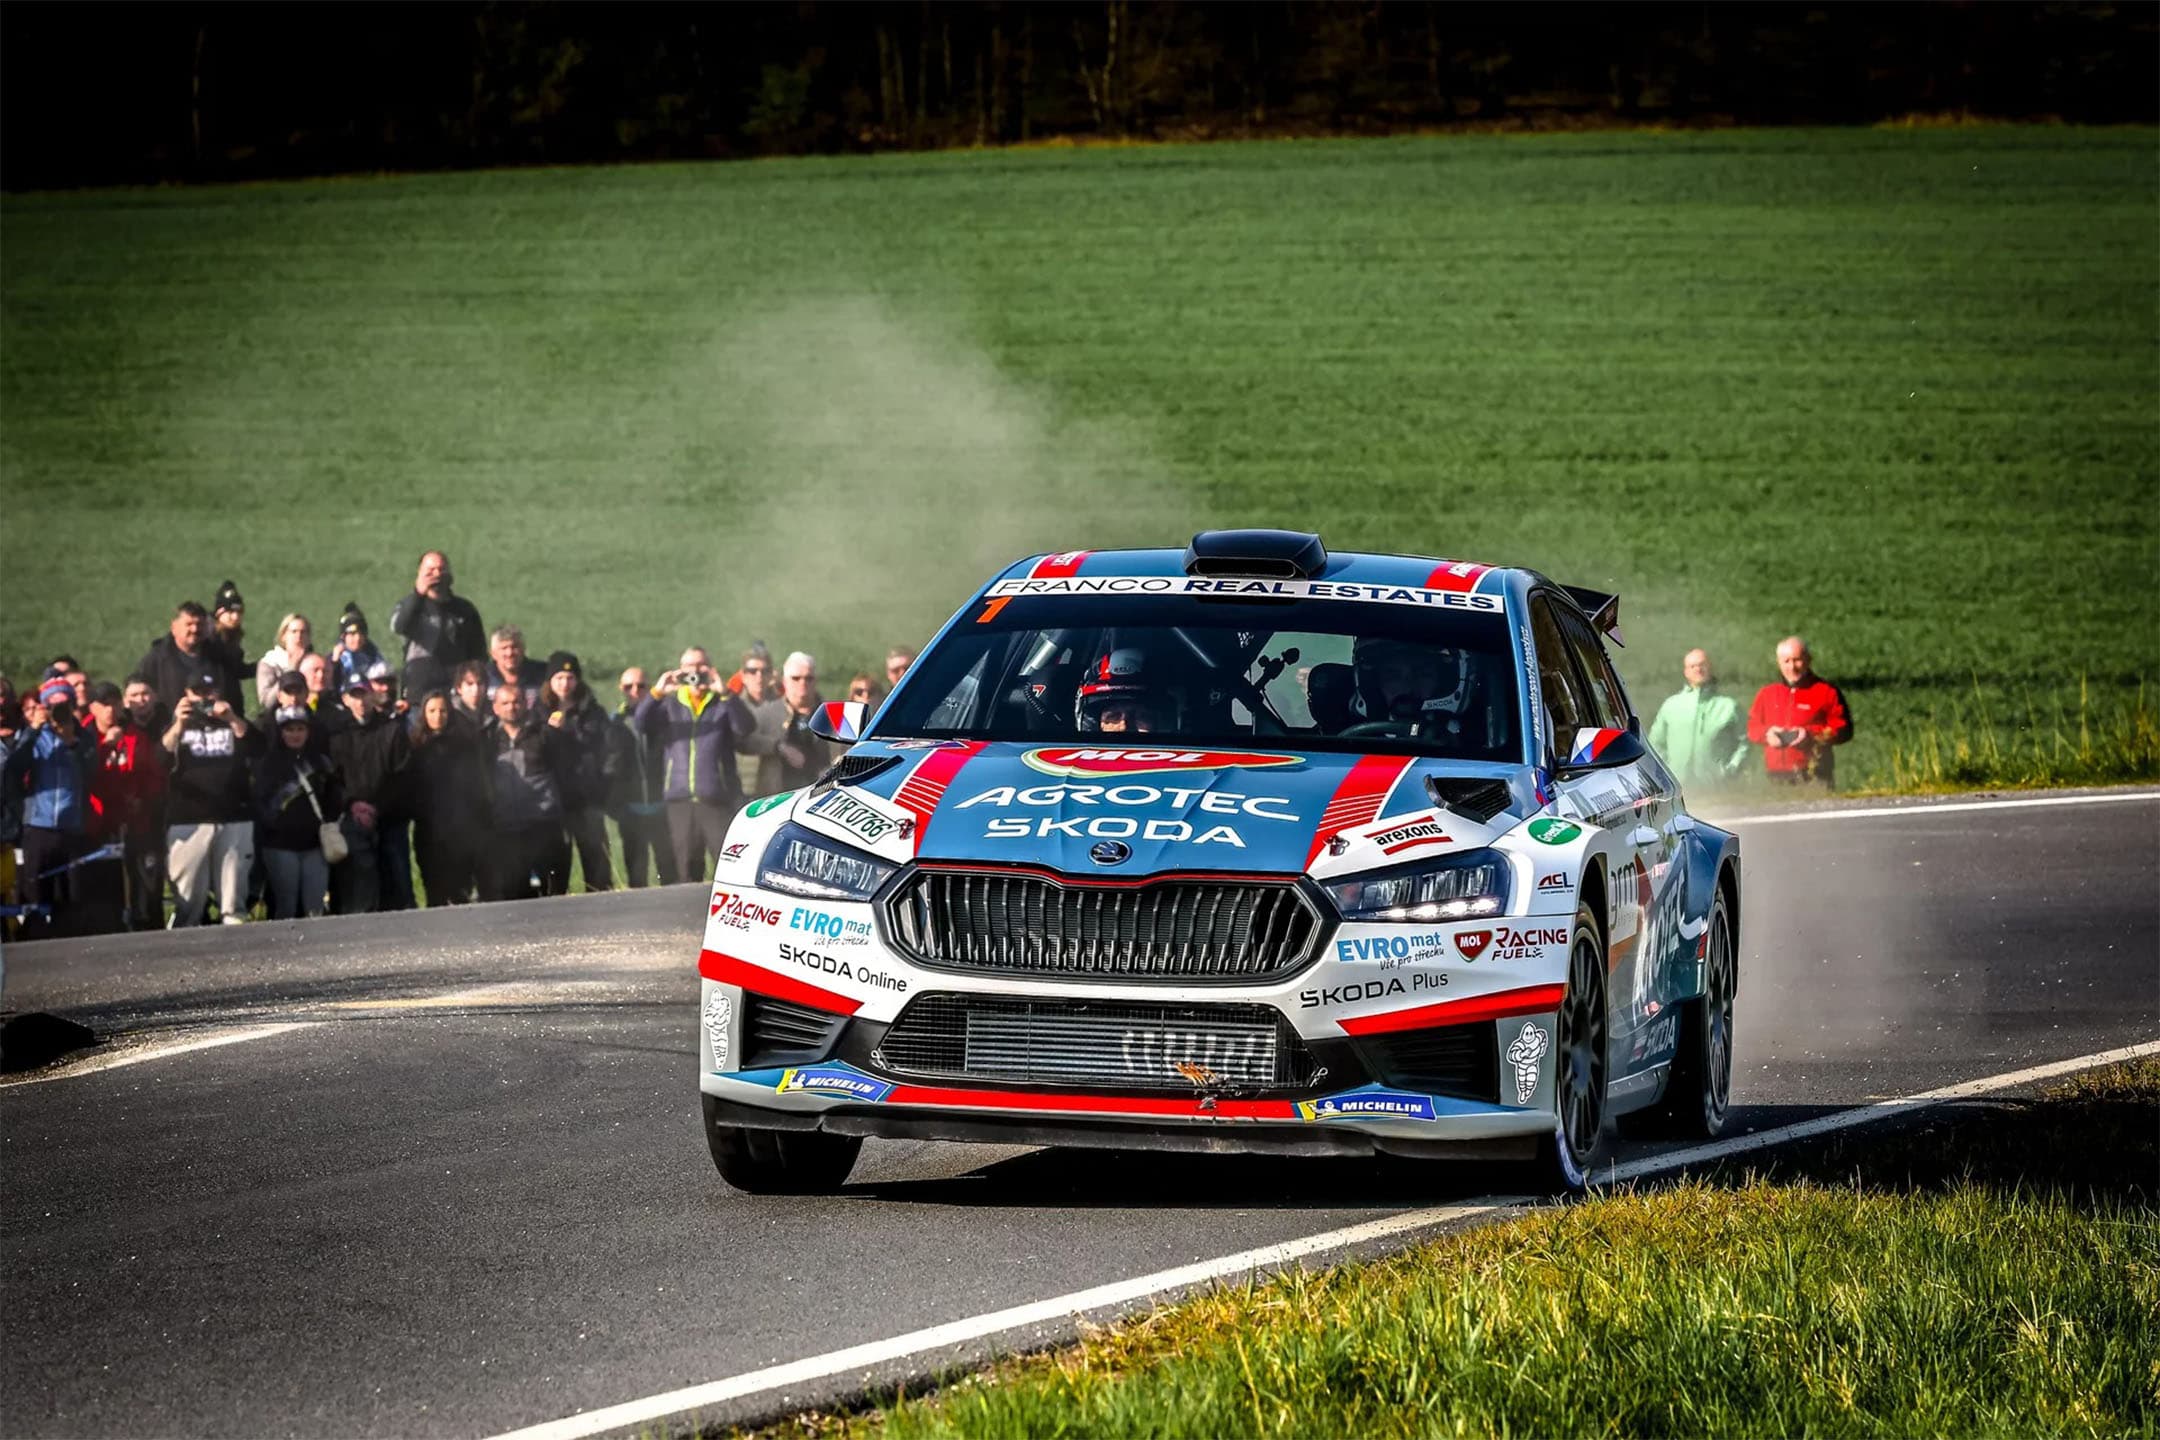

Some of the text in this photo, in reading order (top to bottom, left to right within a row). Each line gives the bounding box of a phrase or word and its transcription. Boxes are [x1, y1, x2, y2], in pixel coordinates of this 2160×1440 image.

[996, 579, 1496, 609] FRANCO REAL ESTATES
[976, 596, 1013, 623] 1
[1057, 750, 1205, 763] MOL
[953, 784, 1300, 822] AGROTEC
[845, 808, 893, 837] 0766
[1374, 823, 1443, 845] arexons
[1538, 871, 1574, 888] ACL
[727, 894, 782, 926] RACING
[790, 907, 872, 938] EVRO mat
[1337, 932, 1442, 962] EVRO mat
[1460, 935, 1481, 948] MOL
[1496, 927, 1567, 948] RACING
[1397, 956, 1412, 970] pro
[857, 967, 907, 992] Online
[1413, 973, 1448, 991] Plus
[806, 1077, 875, 1093] MICHELIN
[1342, 1101, 1422, 1113] MICHELIN
